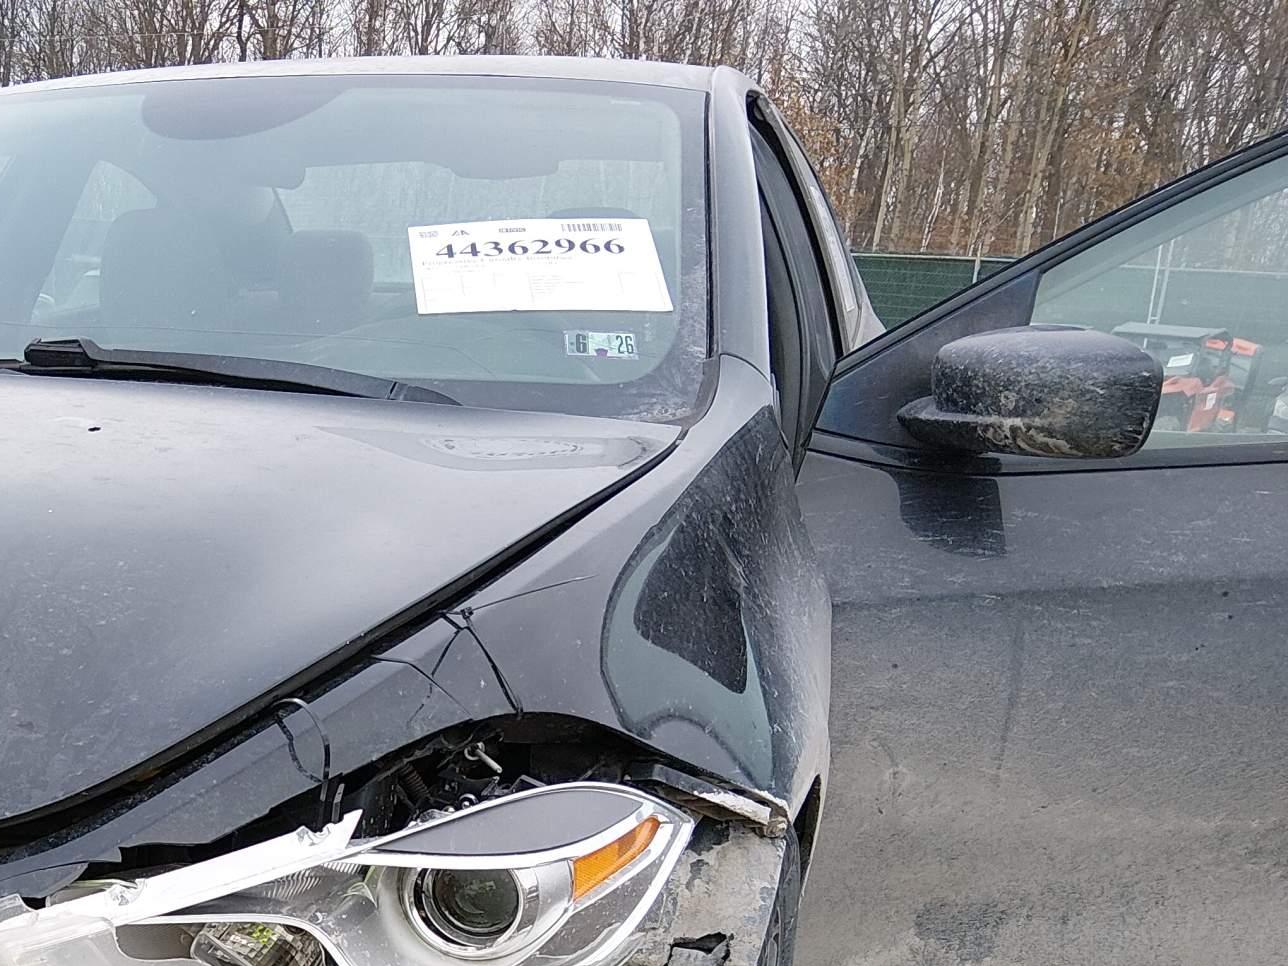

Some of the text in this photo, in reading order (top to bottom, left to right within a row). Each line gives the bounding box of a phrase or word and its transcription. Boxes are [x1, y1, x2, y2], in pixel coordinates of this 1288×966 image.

[435, 237, 625, 259] 44362966
[576, 333, 634, 354] 6 26
